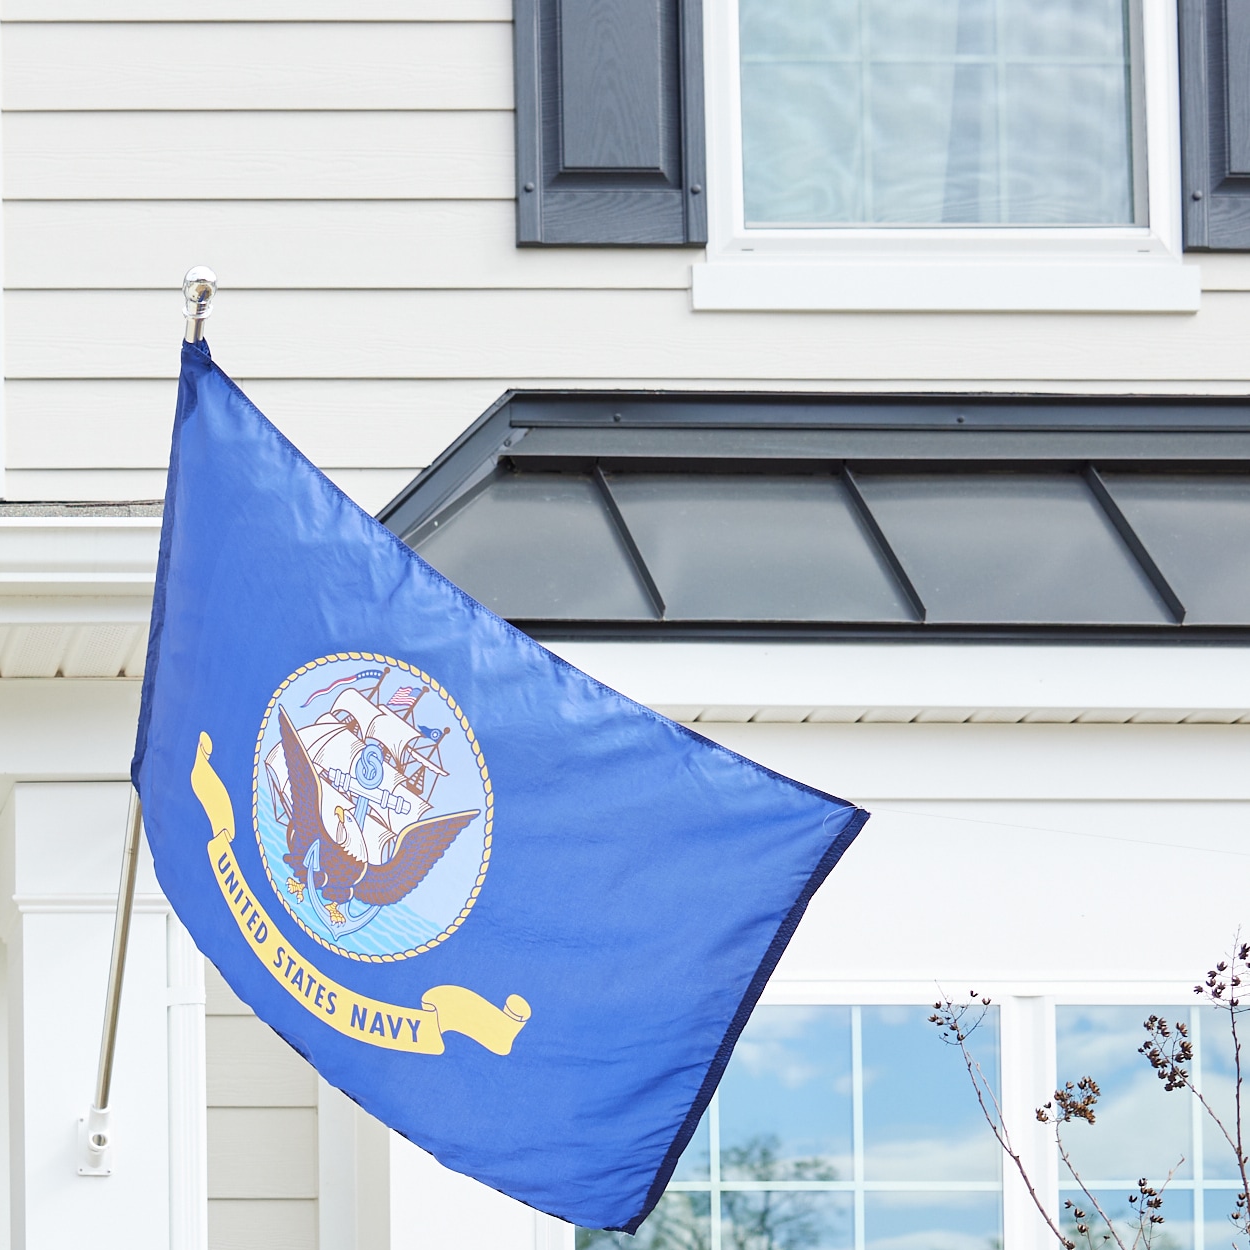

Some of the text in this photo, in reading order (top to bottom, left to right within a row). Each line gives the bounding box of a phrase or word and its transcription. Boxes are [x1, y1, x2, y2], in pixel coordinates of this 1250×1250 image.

[217, 851, 422, 1043] UNITED STATES NAVY
